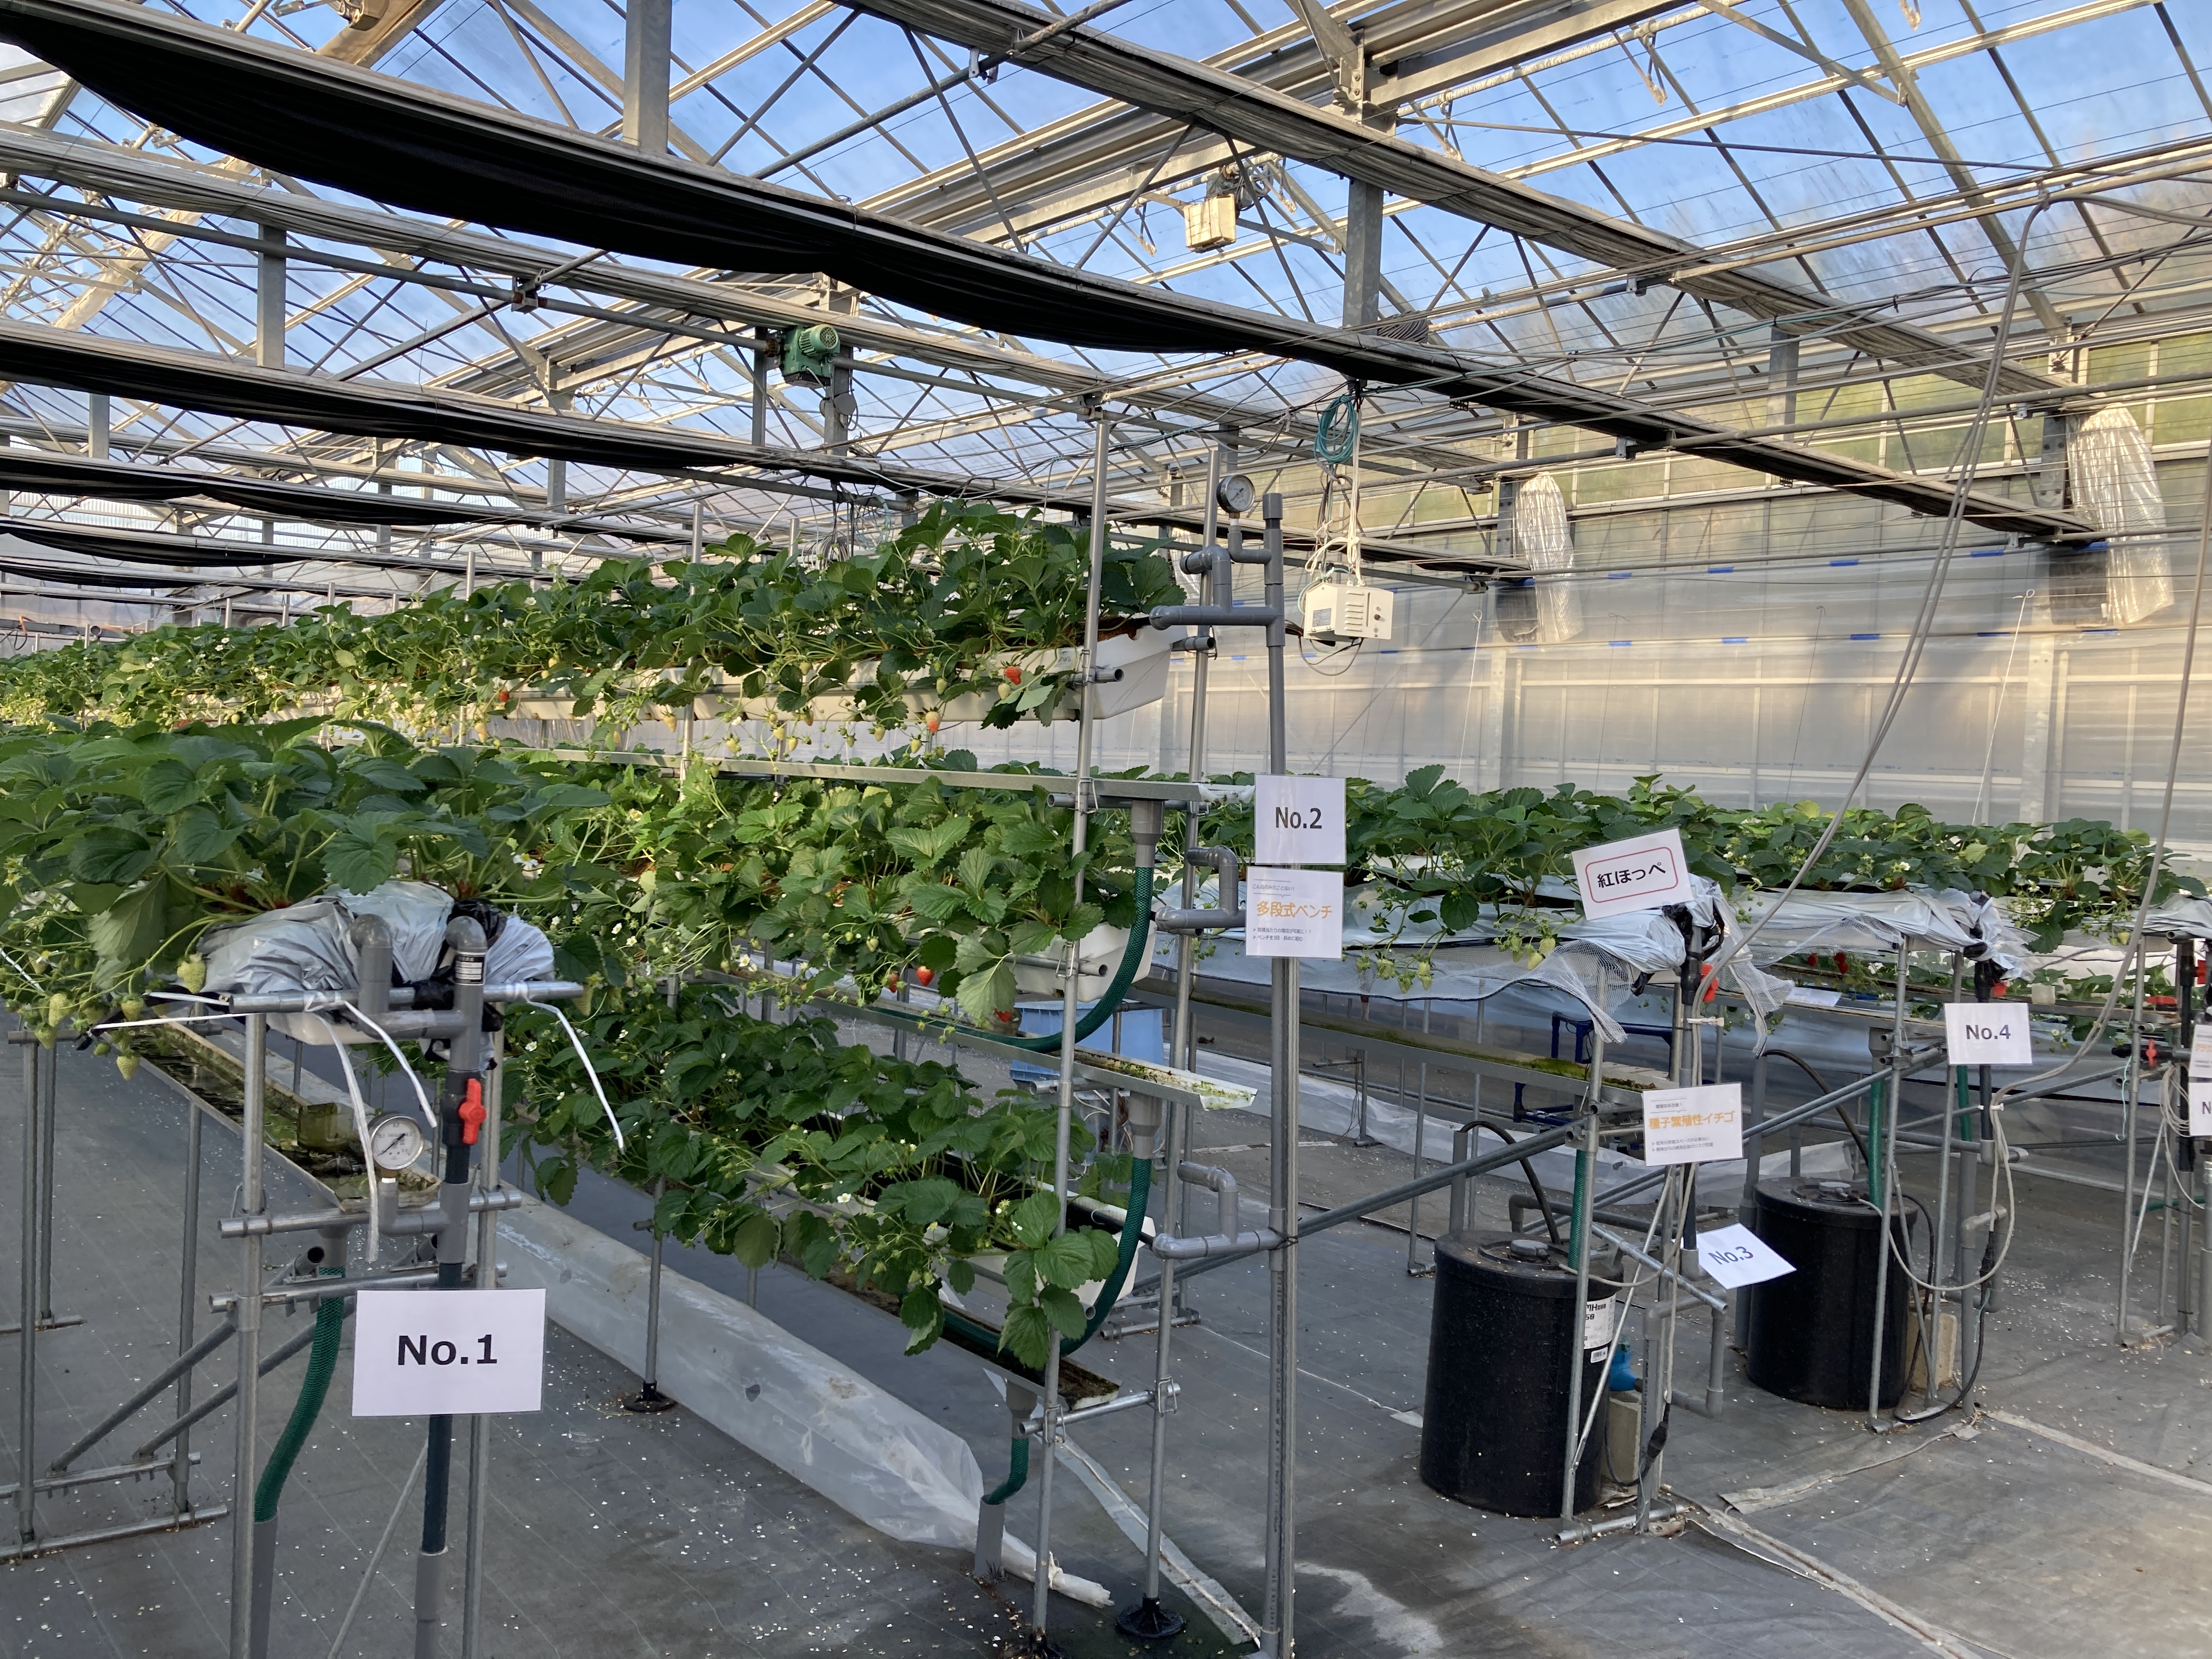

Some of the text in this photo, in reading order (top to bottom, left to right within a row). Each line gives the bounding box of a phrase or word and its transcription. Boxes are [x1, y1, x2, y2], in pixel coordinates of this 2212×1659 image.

[1276, 806, 1322, 829] No.2
[1597, 862, 1666, 888] 紅ほっぺ
[1256, 900, 1333, 919] 多段式ベンチ
[1966, 1024, 2011, 1040] No.4
[1708, 1246, 1754, 1265] No.3
[398, 1334, 497, 1365] No.1
